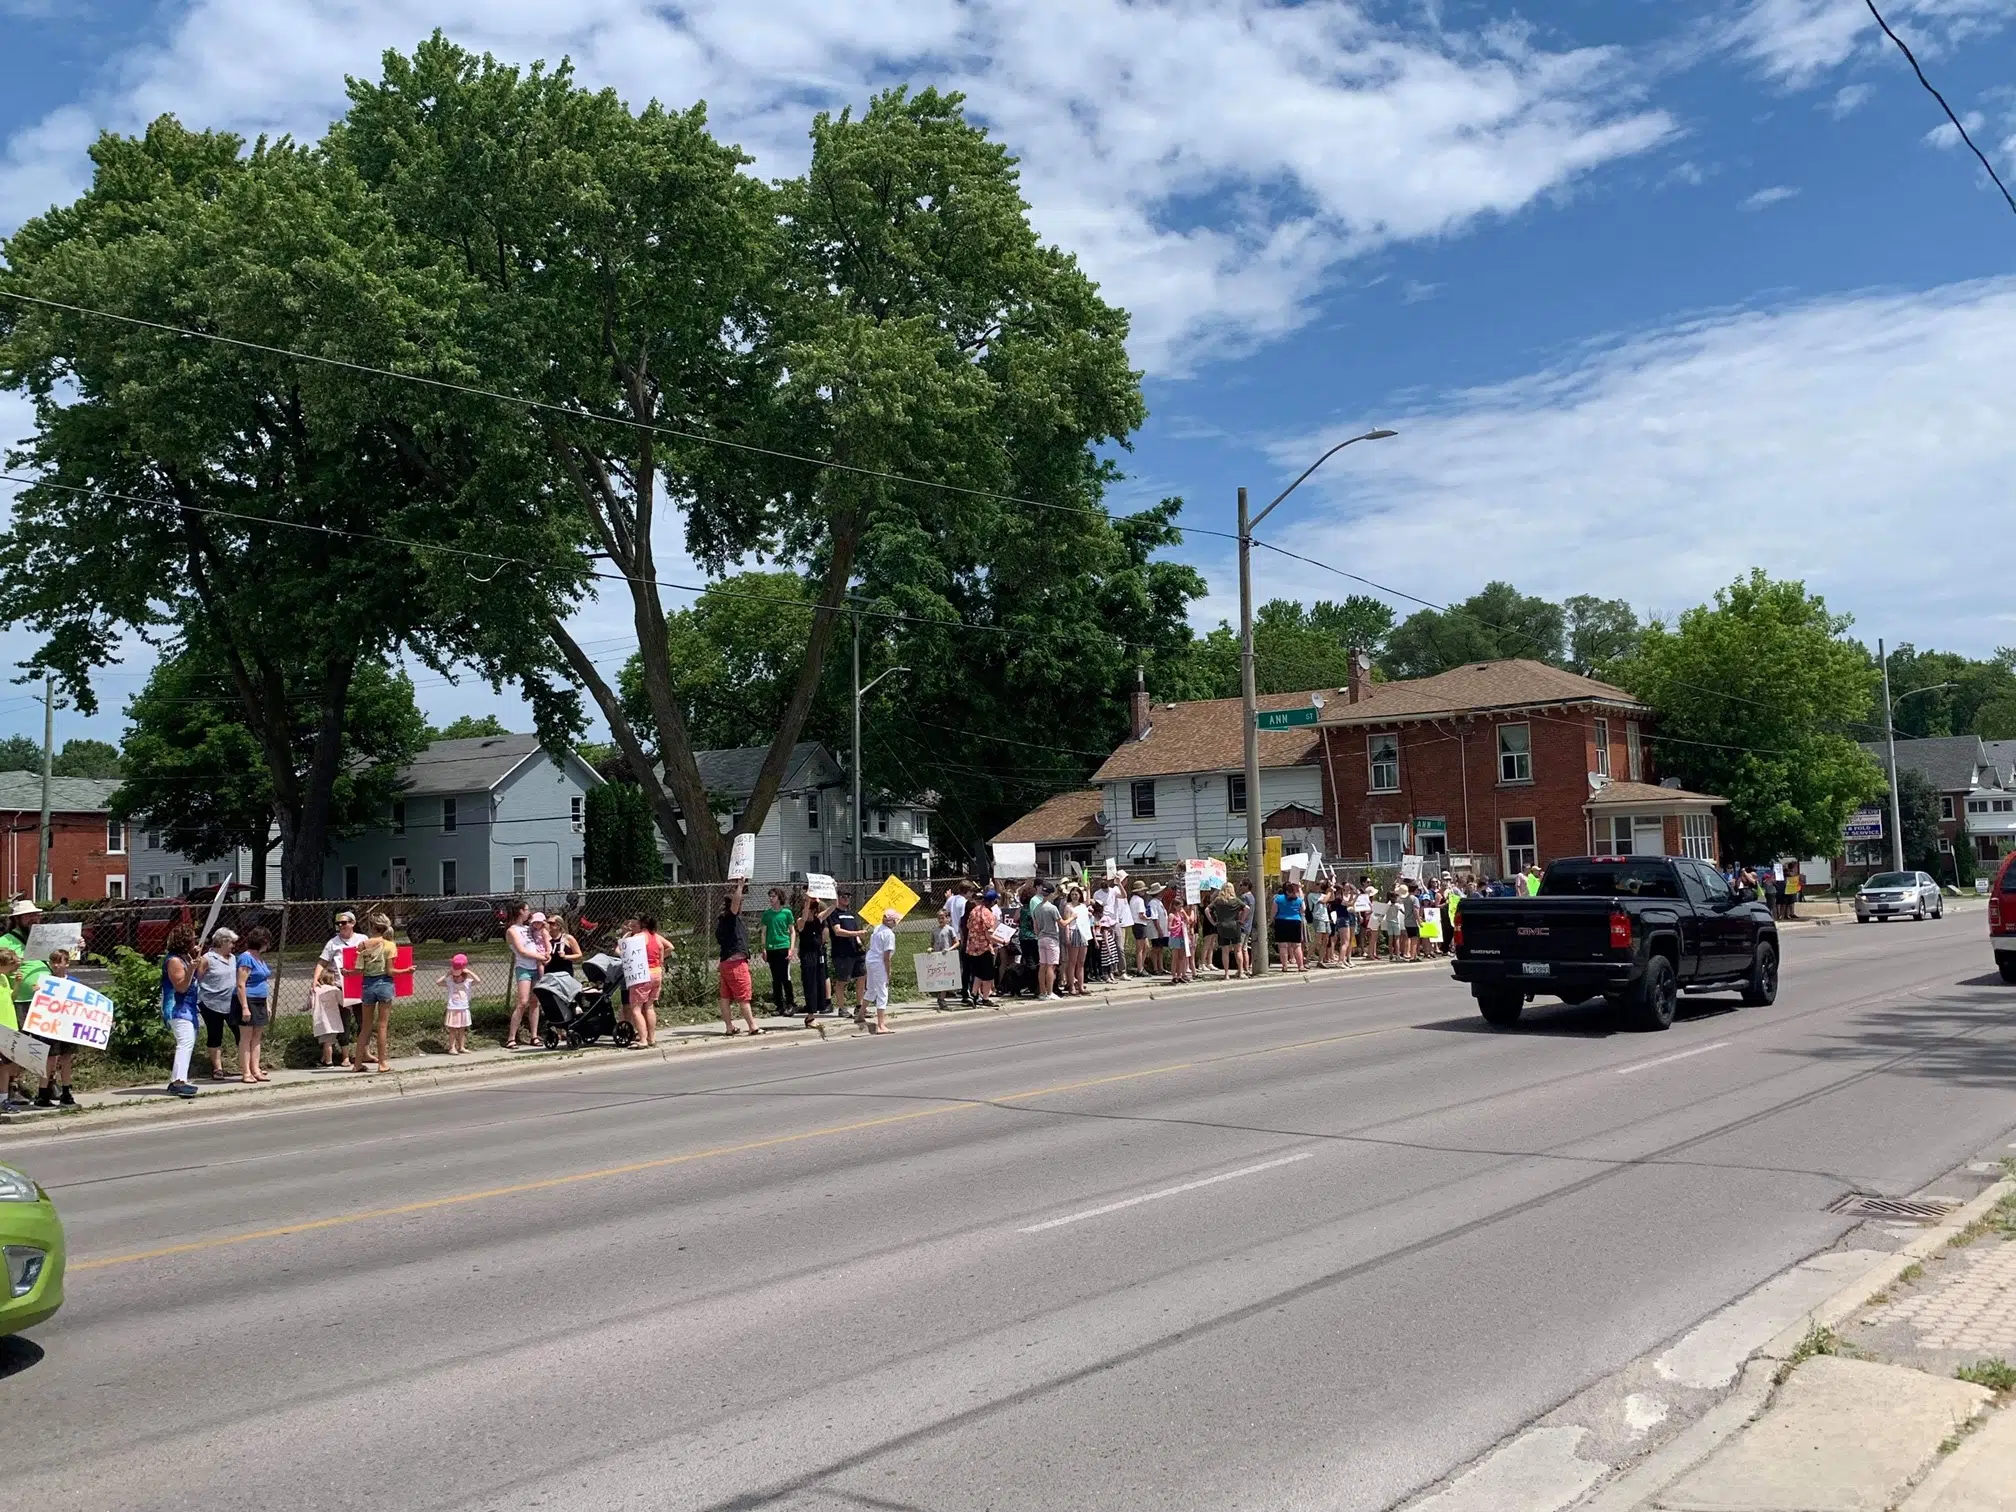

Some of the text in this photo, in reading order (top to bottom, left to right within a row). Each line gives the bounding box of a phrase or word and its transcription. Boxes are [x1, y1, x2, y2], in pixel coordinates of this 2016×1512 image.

[1269, 712, 1314, 725] ANN ST
[1416, 820, 1432, 829] ANN
[1517, 927, 1550, 936] GMC
[631, 948, 642, 956] AT
[42, 980, 113, 1012] I LEFT
[34, 995, 113, 1027] FORTNITE
[72, 1022, 109, 1045] THIS
